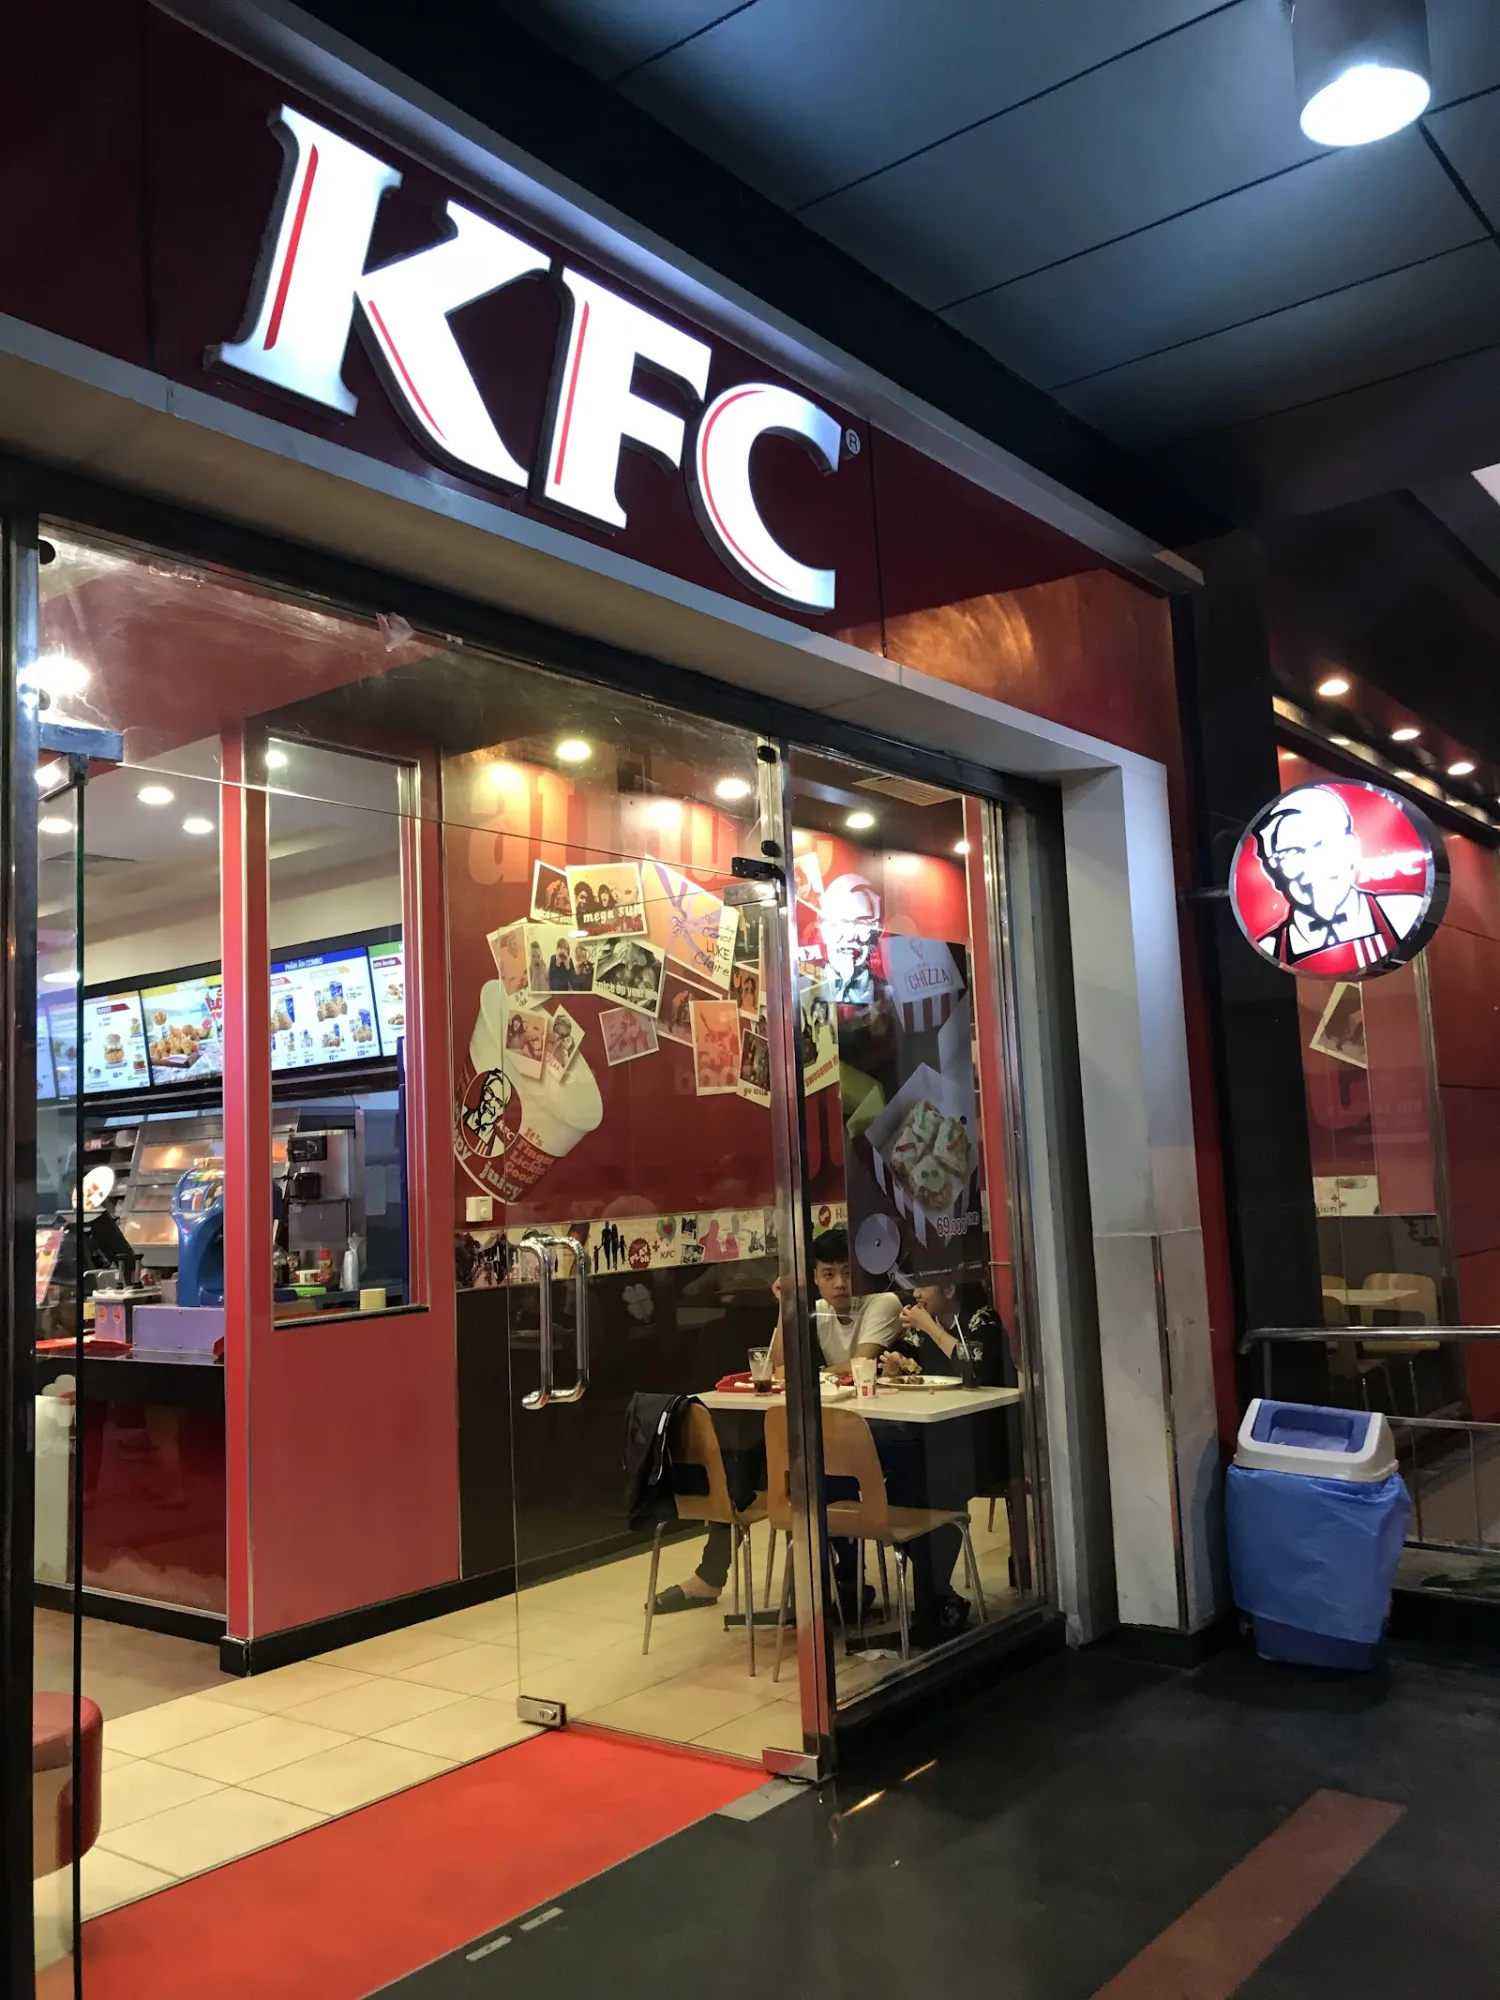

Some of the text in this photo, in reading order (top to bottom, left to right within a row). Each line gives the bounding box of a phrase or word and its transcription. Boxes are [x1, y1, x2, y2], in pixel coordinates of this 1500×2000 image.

[216, 103, 842, 613] KFC
[1356, 850, 1424, 884] KFC
[583, 910, 615, 925] mega
[706, 940, 730, 961] LUKE
[694, 951, 730, 977] Claire
[907, 966, 950, 990] CHIZZA
[805, 1060, 834, 1088] awesome
[743, 1088, 752, 1097] go
[496, 1119, 515, 1141] KFC
[524, 1127, 545, 1148] It's
[479, 1161, 524, 1201] juicy
[660, 1250, 675, 1259] KFC
